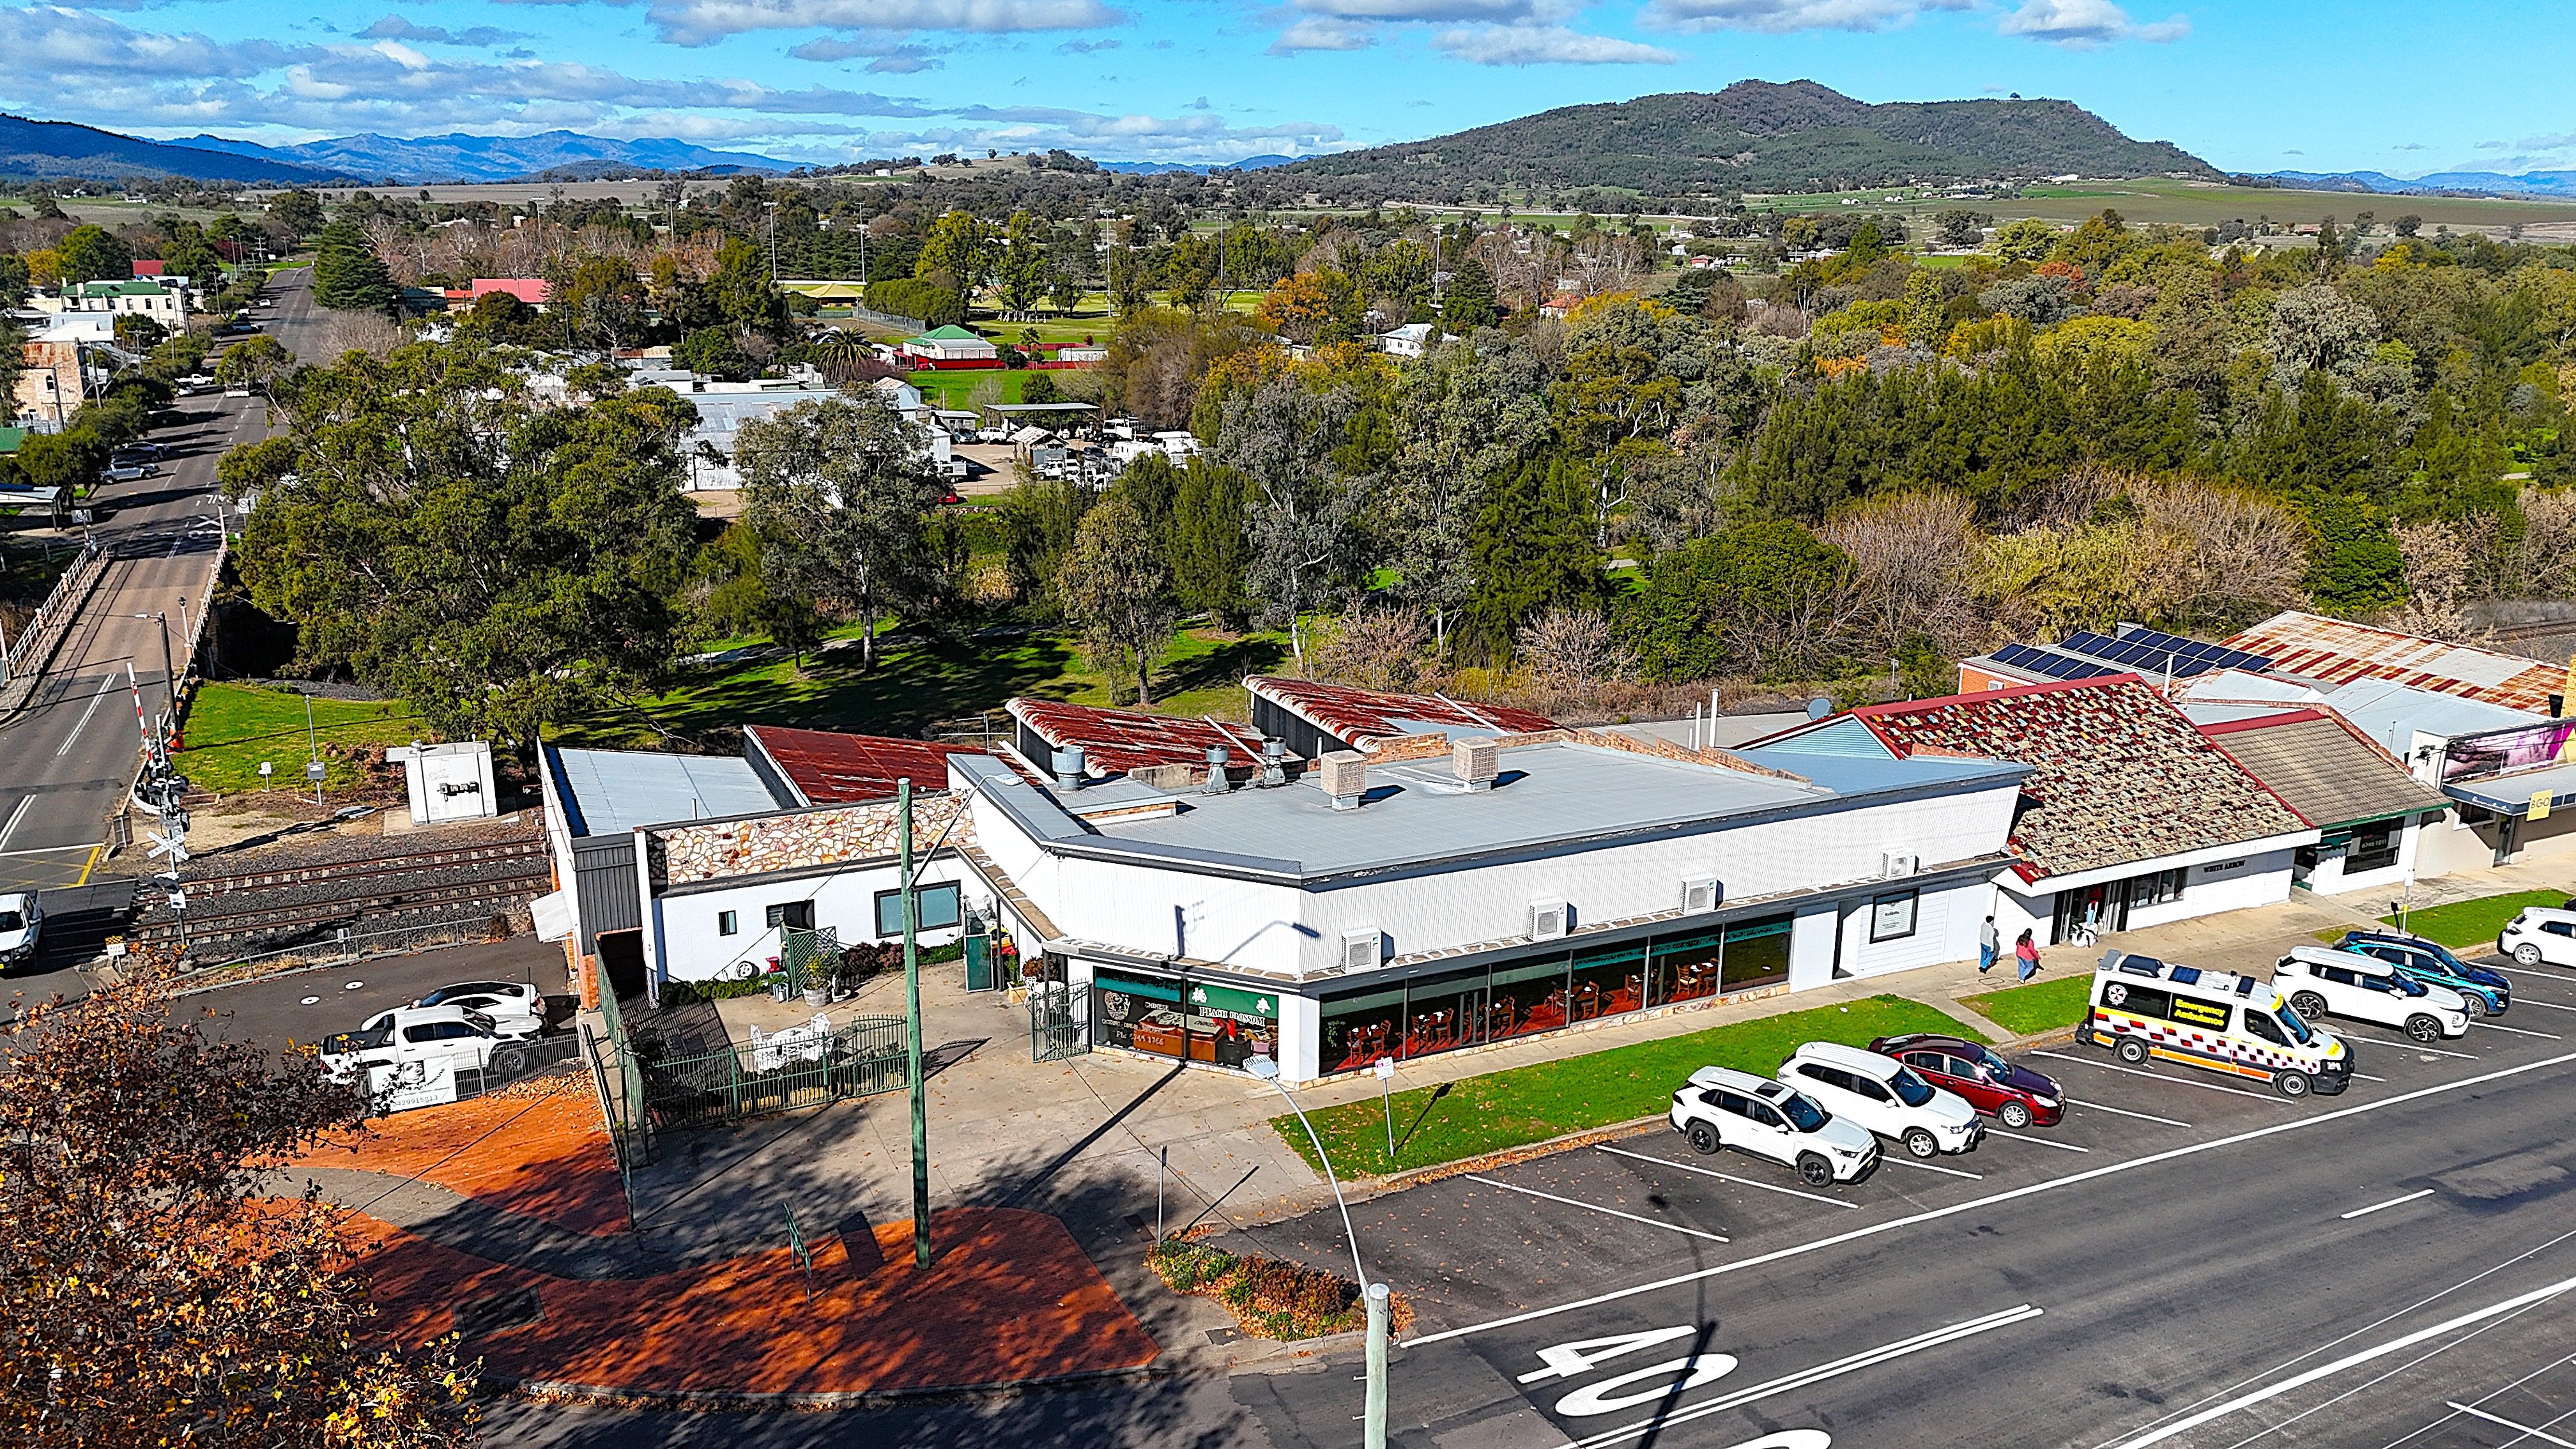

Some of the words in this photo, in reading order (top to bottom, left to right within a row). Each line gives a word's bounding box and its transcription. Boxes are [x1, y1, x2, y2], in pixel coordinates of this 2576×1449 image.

[1144, 1001, 1169, 1011] CHINESE
[2175, 999, 2226, 1017] Emergency
[1199, 1006, 1228, 1018] PEACH
[1229, 1011, 1266, 1027] BLOSSOM
[2174, 1009, 2225, 1026] Ambulance
[1517, 1325, 1738, 1416] 40
